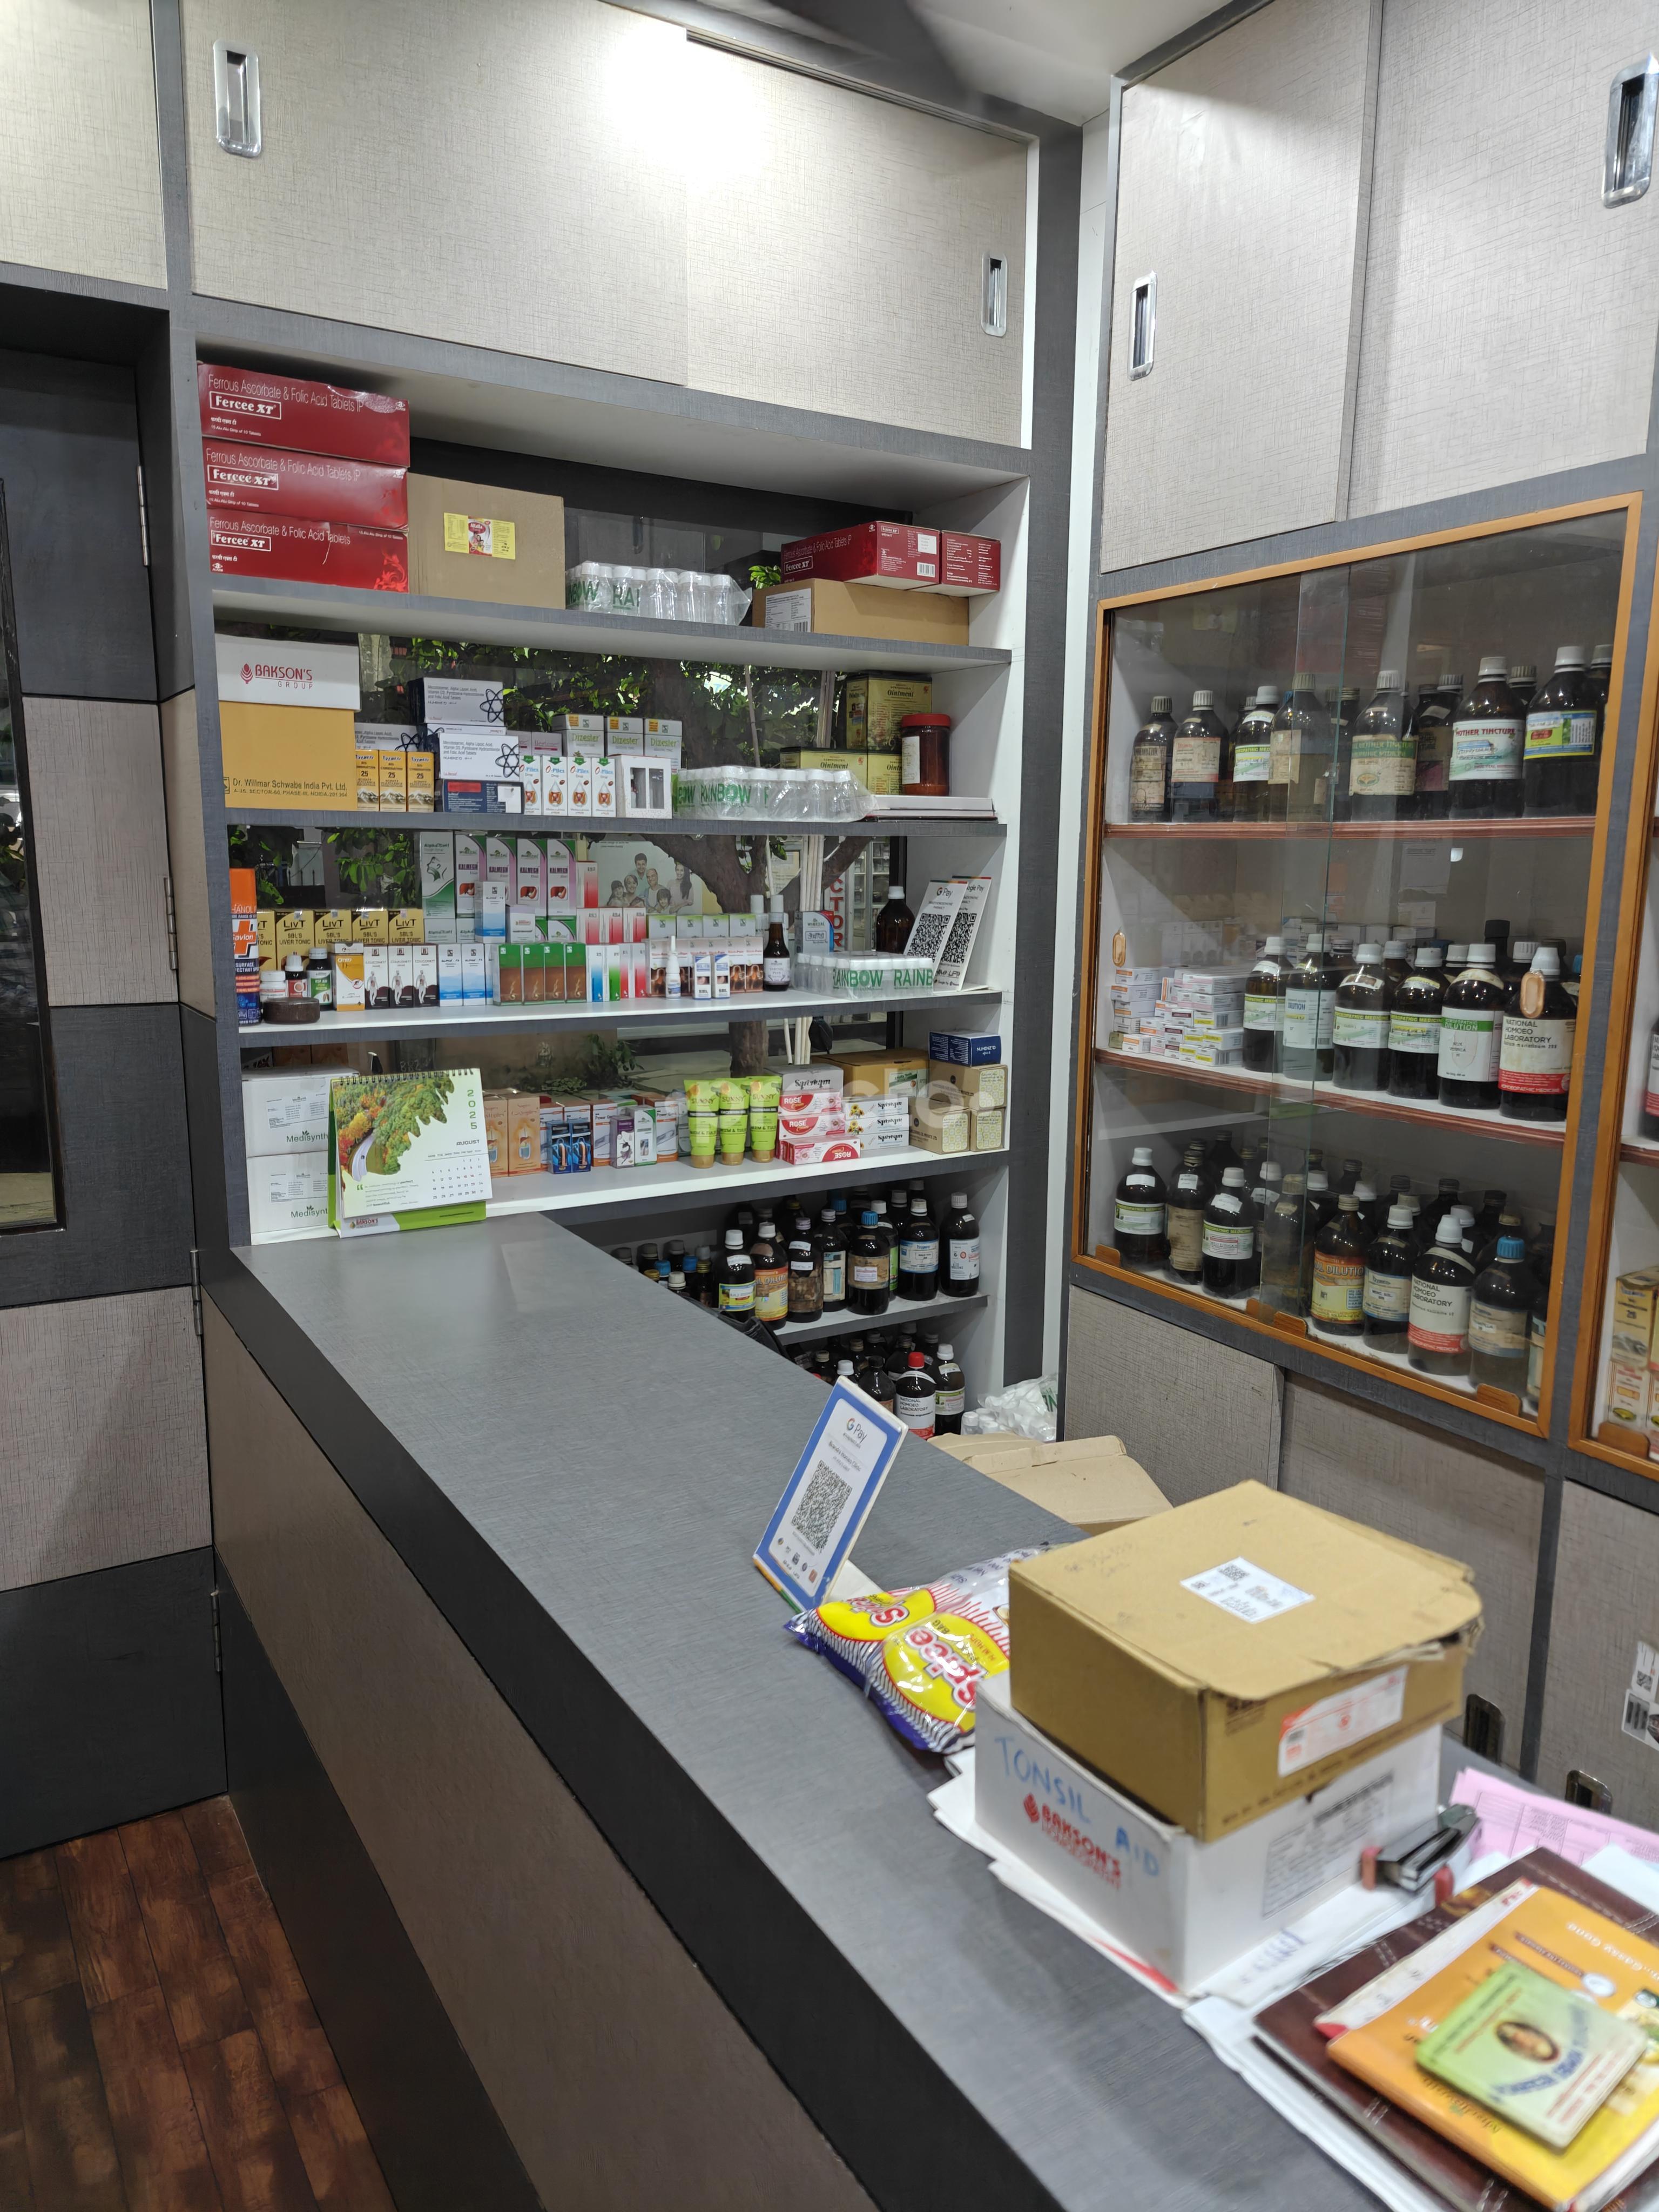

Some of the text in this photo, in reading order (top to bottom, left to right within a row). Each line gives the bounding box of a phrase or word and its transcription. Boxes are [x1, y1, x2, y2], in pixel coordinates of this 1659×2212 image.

[208, 374, 364, 412] Ferrous Ascorbate & Folic Acid Tablets IP
[215, 395, 274, 415] Fercee XT
[206, 448, 360, 481] Ferrous Ascorbate & Folic Acid Tablets IP
[213, 468, 271, 485] Fercee XT
[210, 516, 350, 545] Ferrous Ascorbate & Folic Acid Tablets
[216, 534, 265, 548] Fercee XT
[786, 562, 801, 572] Fercee
[255, 664, 312, 681] BAKSON'S
[278, 680, 313, 690] GROUP
[887, 689, 914, 697] Ointment
[572, 733, 599, 742] Dizester
[612, 735, 638, 745] Dizester
[651, 738, 677, 747] Dizester
[233, 778, 242, 786] Dr.
[244, 779, 270, 788] Willmar
[272, 780, 302, 790] Schwabe
[304, 782, 320, 790] India
[701, 783, 752, 804] RAINBOW
[943, 888, 953, 899] Pay
[833, 969, 883, 988] RAINBOW
[1445, 1022, 1478, 1031] DILUTION
[1505, 1034, 1552, 1043] LABORATORY
[286, 1132, 328, 1143] Medisynth
[291, 1208, 328, 1218] Medisynt
[1326, 1265, 1365, 1276] DILUTIO
[1414, 1278, 1440, 1292] NATIONAL
[1412, 1293, 1453, 1307] LABORATORY
[854, 1422, 867, 1442] Pay
[995, 1735, 1160, 1877] TONSIL AID
